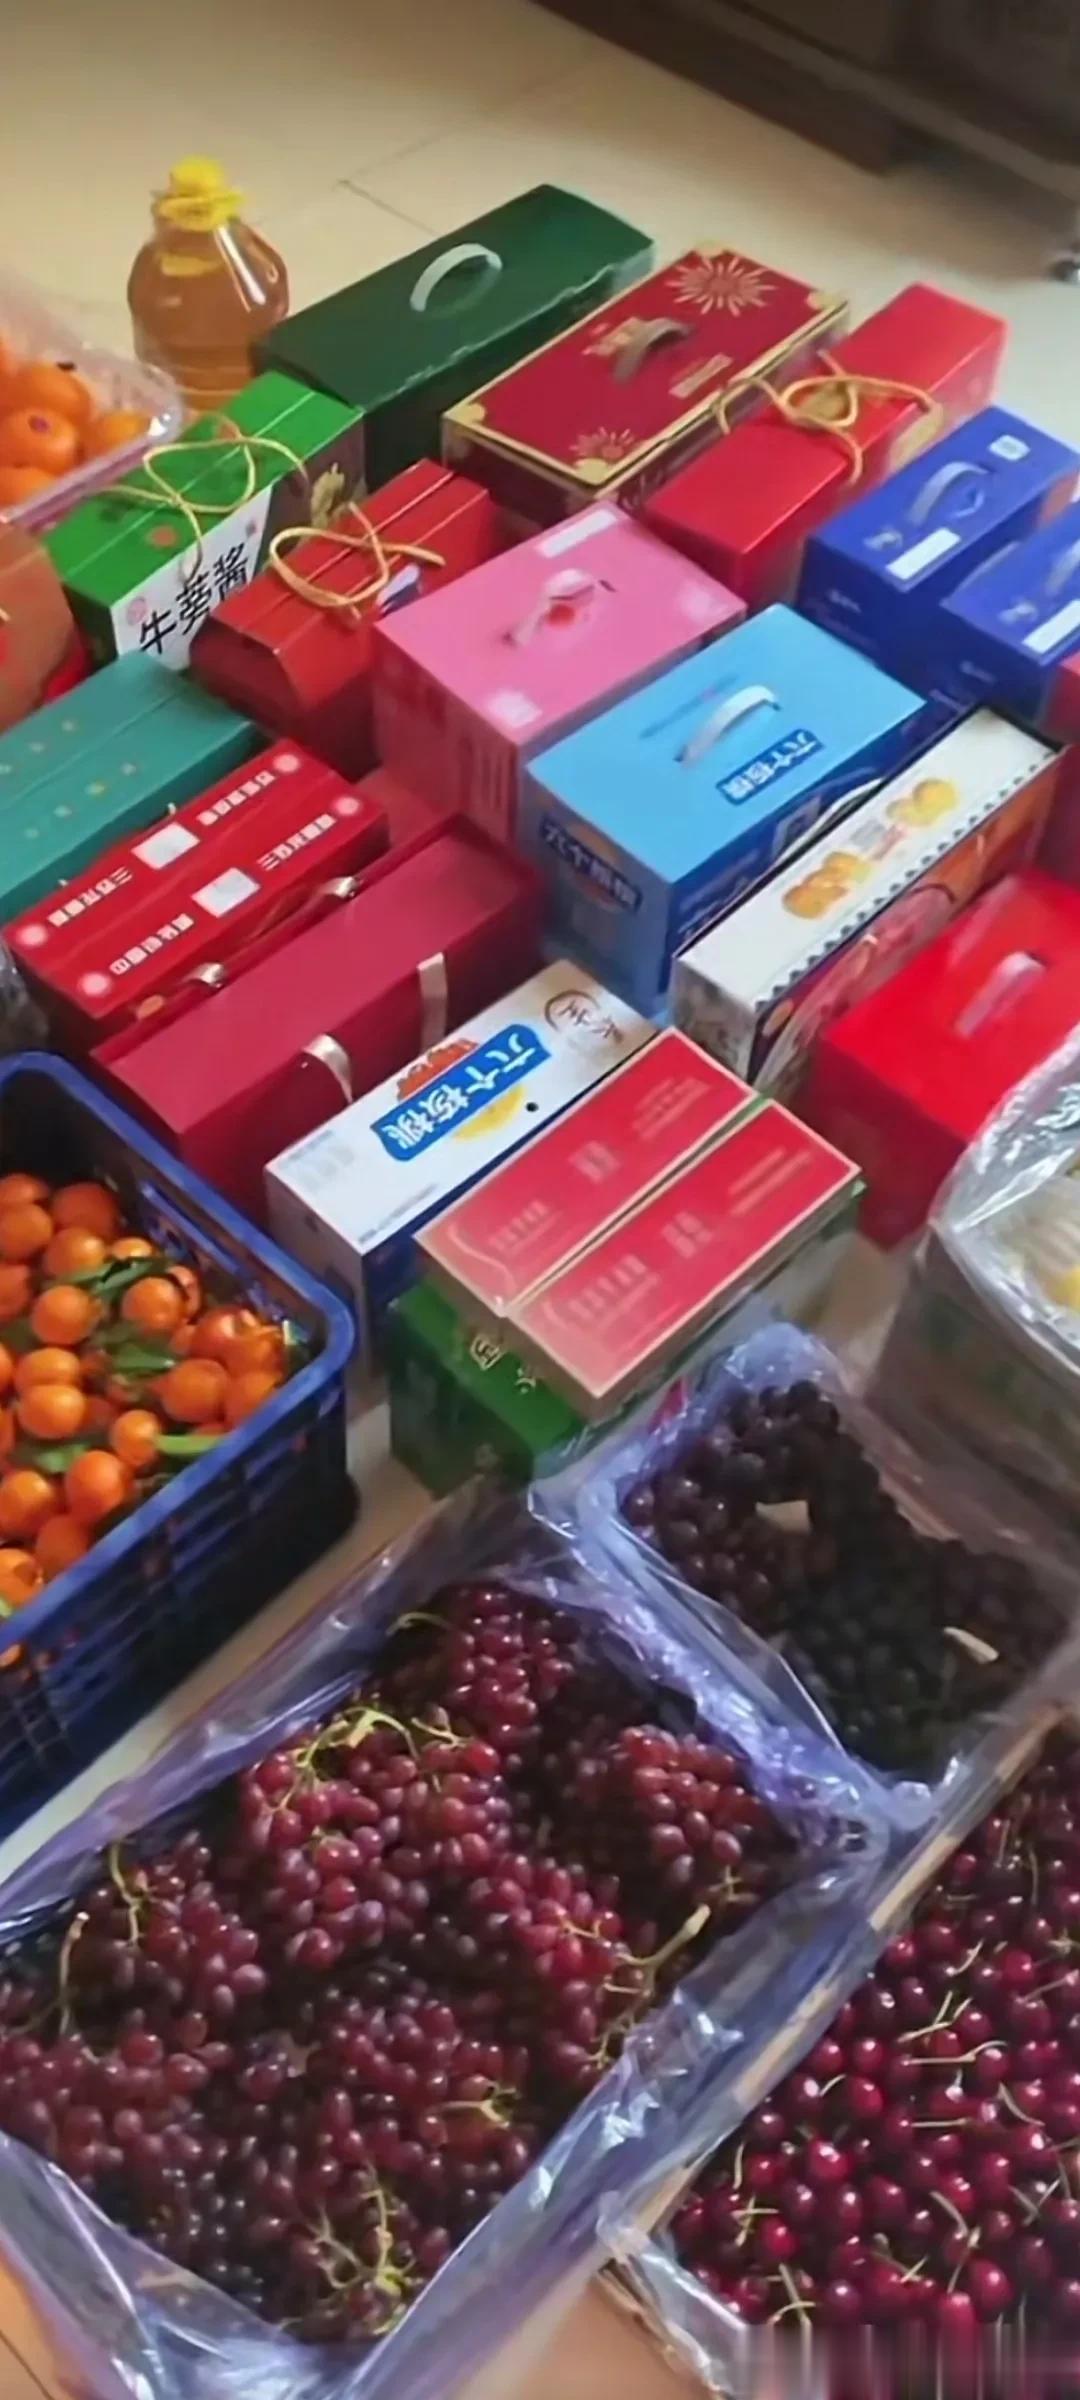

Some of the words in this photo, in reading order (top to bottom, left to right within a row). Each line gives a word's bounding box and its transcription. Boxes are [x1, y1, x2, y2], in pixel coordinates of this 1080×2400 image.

[140, 543, 248, 655] 牛蒡酱
[381, 1033, 535, 1149] 六个核桃
